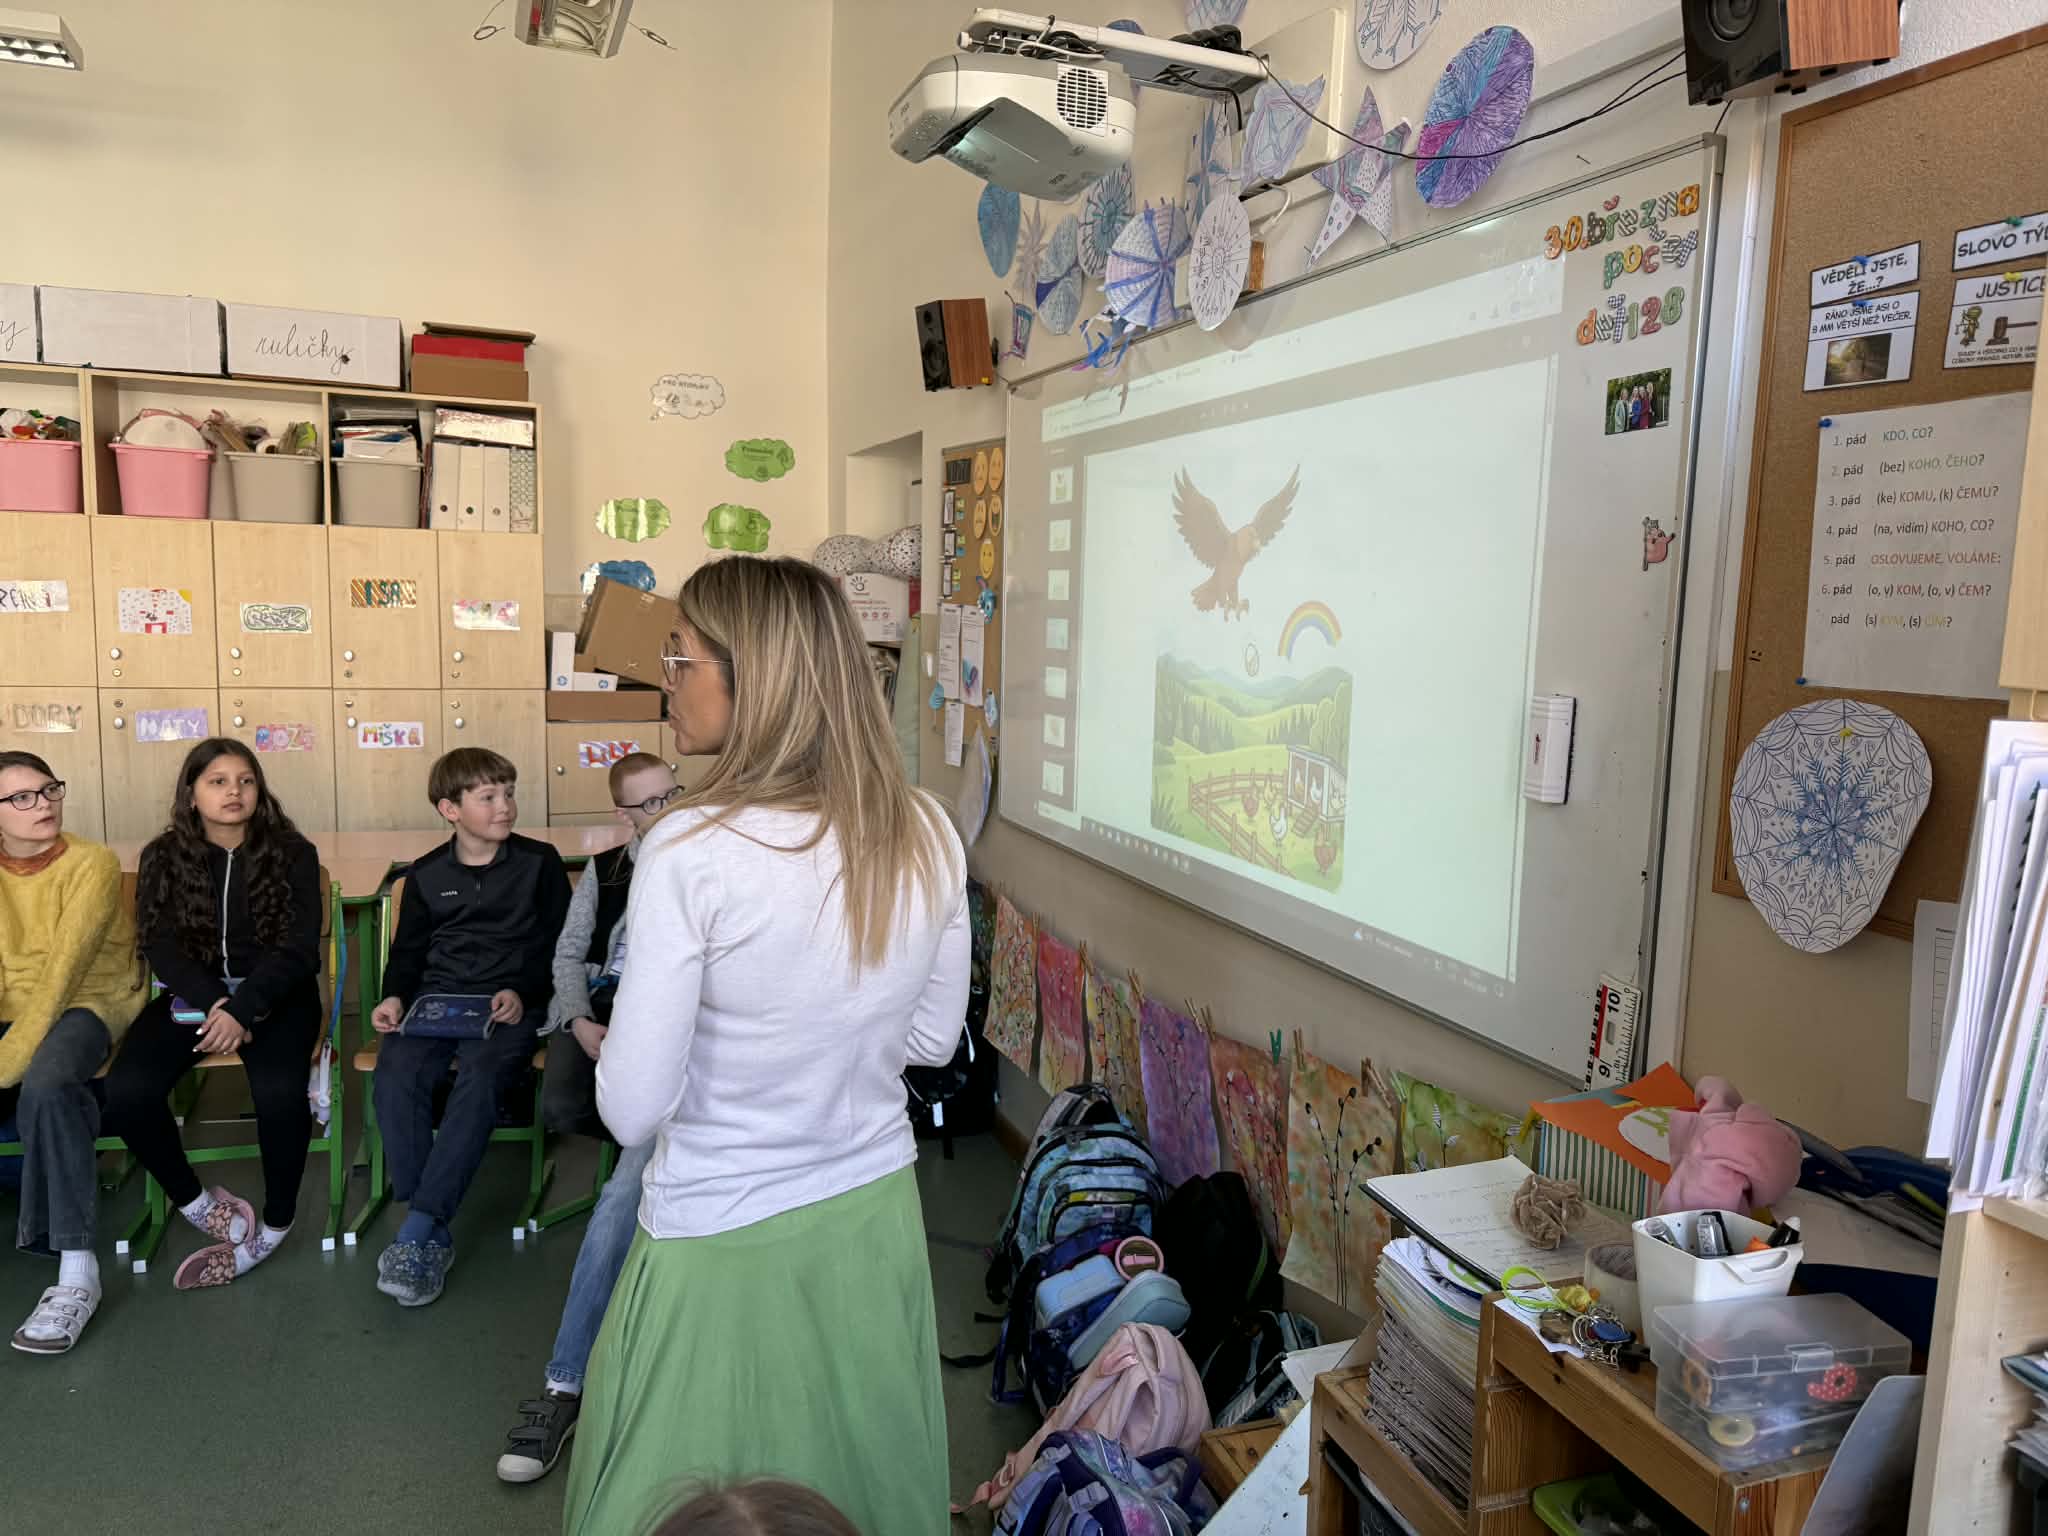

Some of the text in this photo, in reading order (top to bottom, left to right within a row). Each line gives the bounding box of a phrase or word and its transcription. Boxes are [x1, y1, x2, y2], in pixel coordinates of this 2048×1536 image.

[1957, 232, 2017, 258] SLOVO
[1825, 308, 1848, 321] RÁNO
[1875, 302, 1890, 312] ASI
[1846, 434, 1866, 448] pád
[1912, 426, 1934, 440] CO?
[1843, 464, 1863, 478] pád
[1879, 461, 1905, 475] (bez)
[1841, 494, 1861, 508] pád
[1877, 492, 1897, 505] (ke)
[1939, 488, 1953, 503] (k)
[1956, 485, 1999, 500] ČEMU?
[1838, 524, 1858, 537] pád
[1873, 522, 1893, 536] (na,
[1970, 518, 1994, 532] CO?
[1835, 554, 1855, 568] pád
[1833, 583, 1852, 597] pád
[1958, 581, 1991, 597] ČEM?
[1831, 612, 1850, 626] pád
[1865, 614, 1878, 627] (s)
[1908, 615, 1921, 629] (s)
